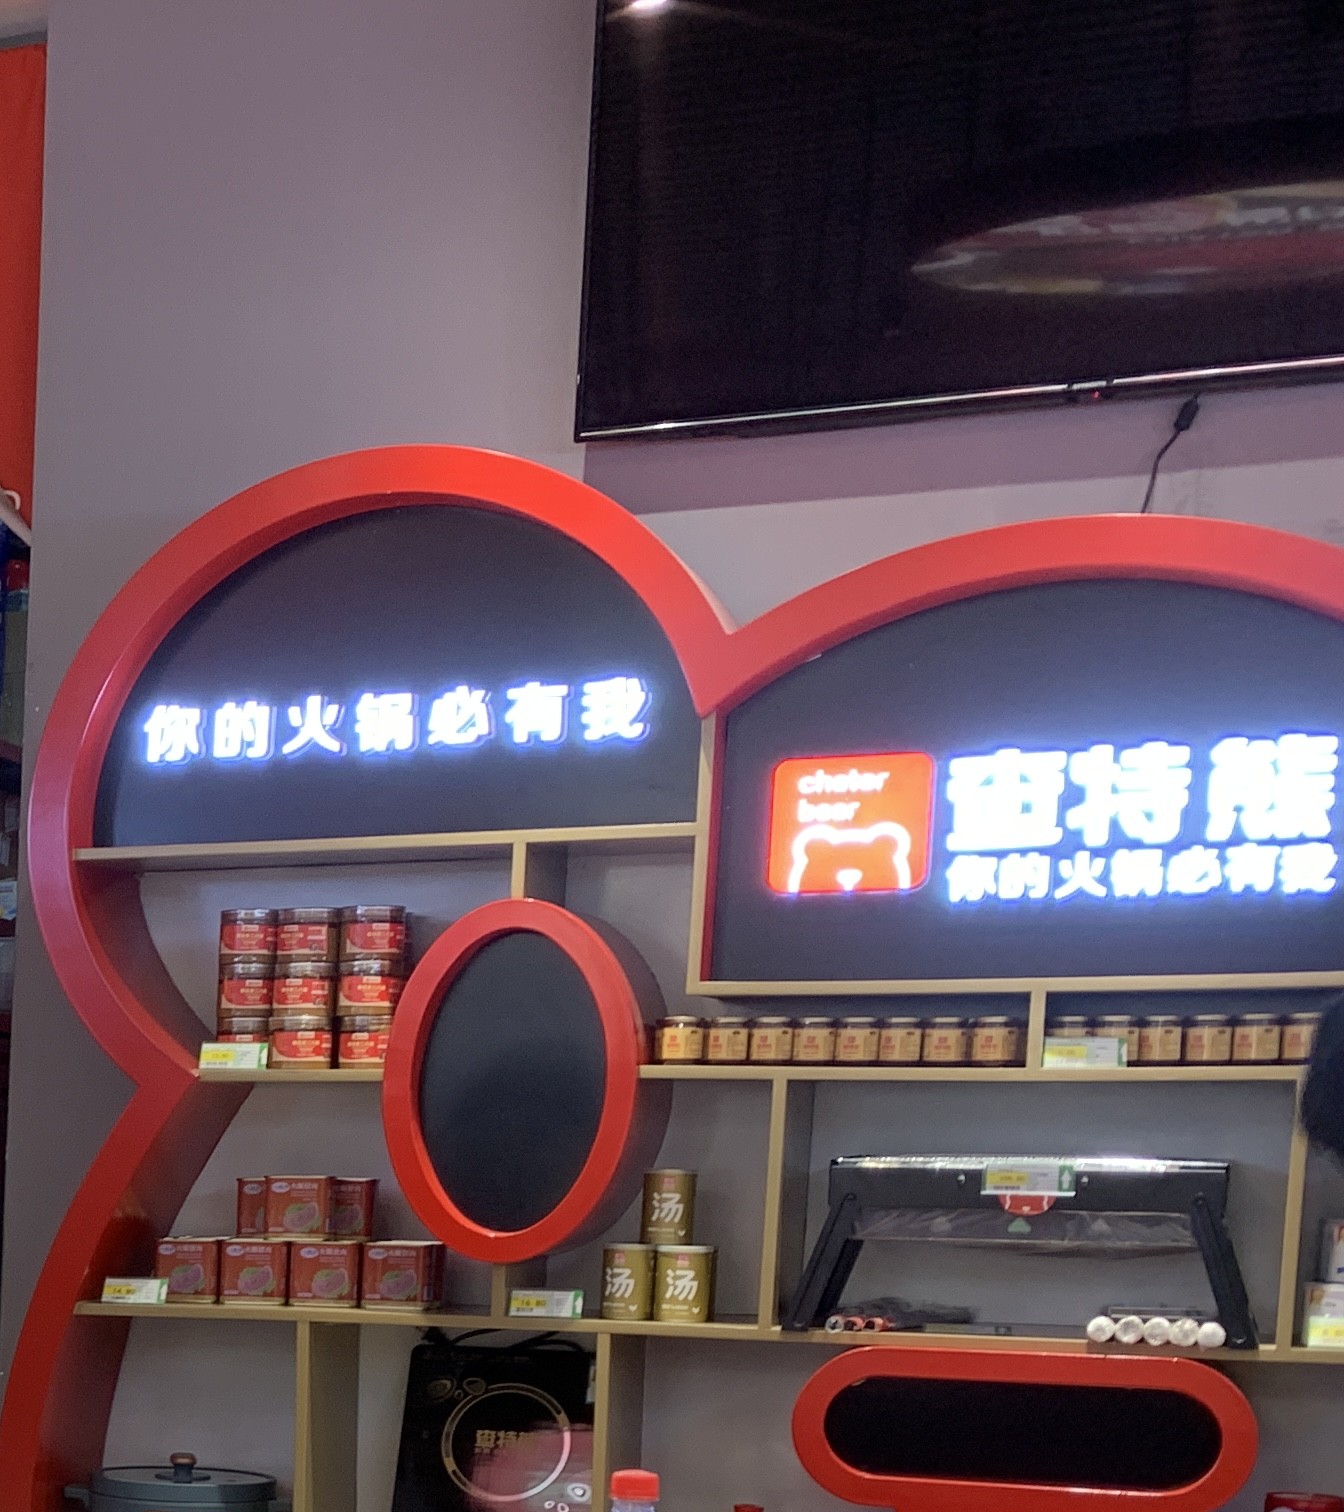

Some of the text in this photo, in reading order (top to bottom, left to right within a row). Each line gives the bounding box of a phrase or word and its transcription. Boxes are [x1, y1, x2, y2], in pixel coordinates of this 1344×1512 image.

[144, 676, 654, 764] 你的火锅必有我
[946, 733, 1340, 852] 查特熊
[652, 1192, 685, 1223] 汤
[604, 1267, 635, 1299] 汤
[665, 1268, 699, 1300] 汤
